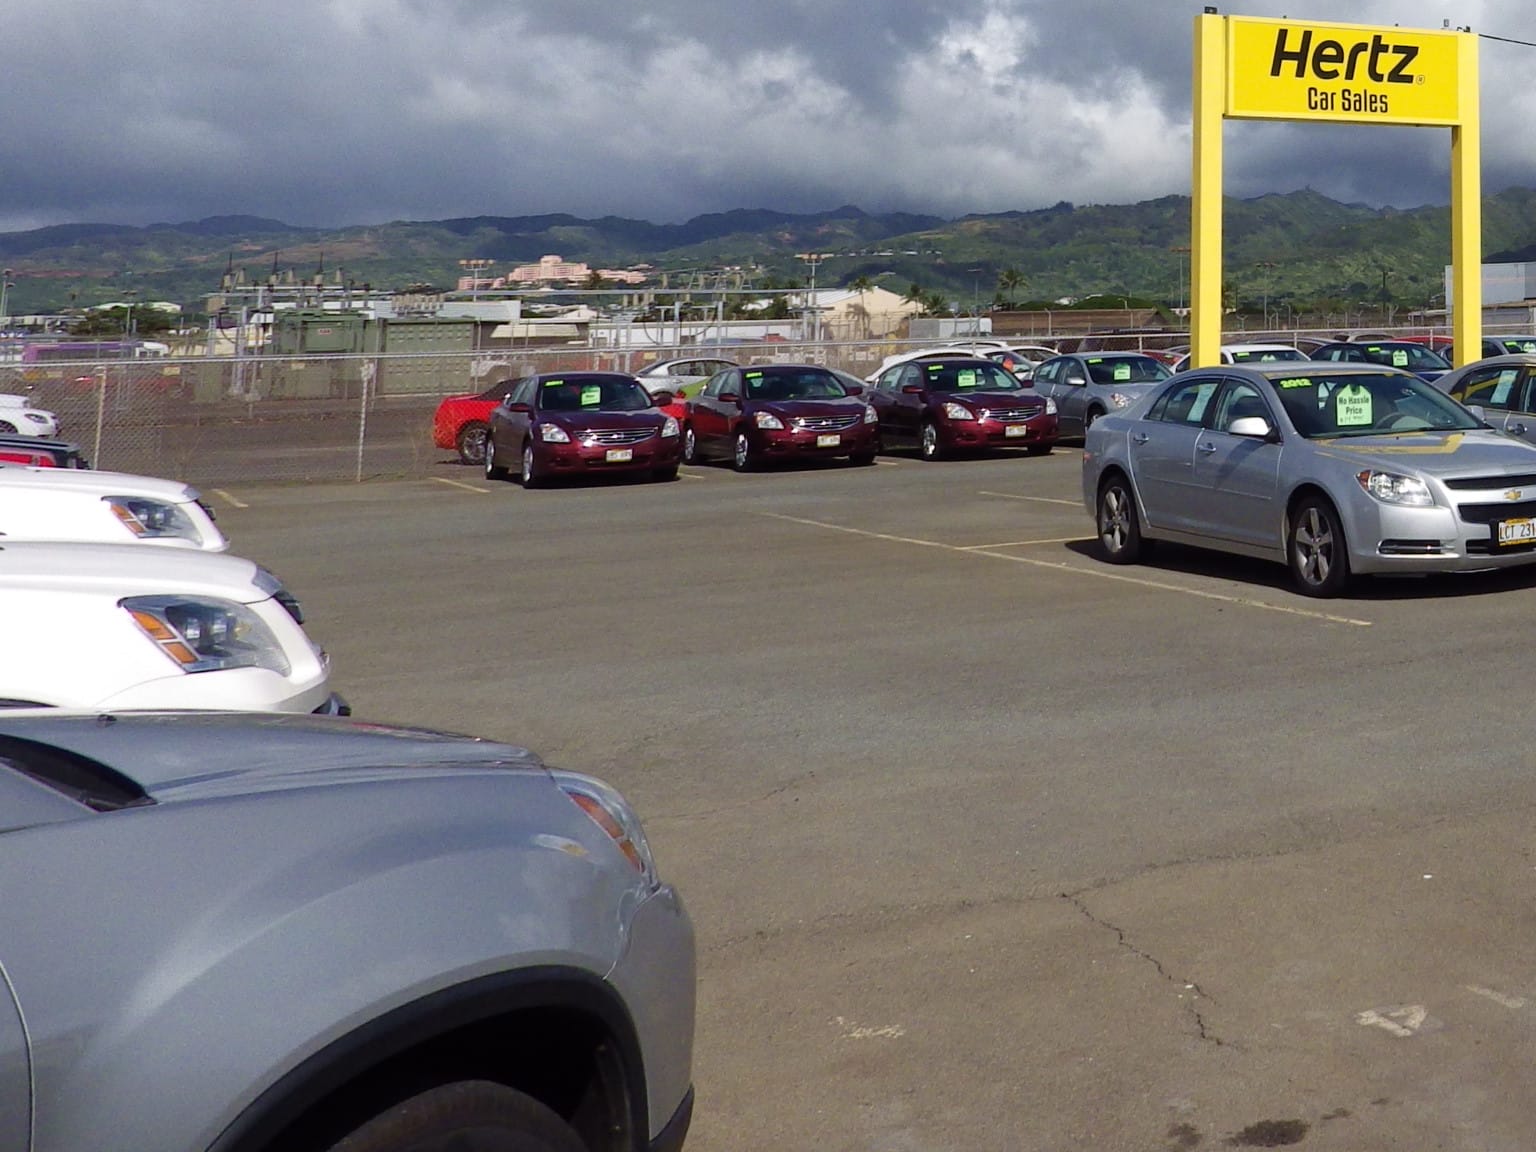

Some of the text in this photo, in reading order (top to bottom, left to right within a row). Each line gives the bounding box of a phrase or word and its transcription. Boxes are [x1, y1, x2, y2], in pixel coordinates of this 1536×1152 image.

[1270, 29, 1419, 84] Hertz
[1308, 87, 1388, 113] Car Sales
[1279, 378, 1312, 388] 2012
[1345, 406, 1363, 415] Price
[1499, 522, 1536, 540] LCT 231
